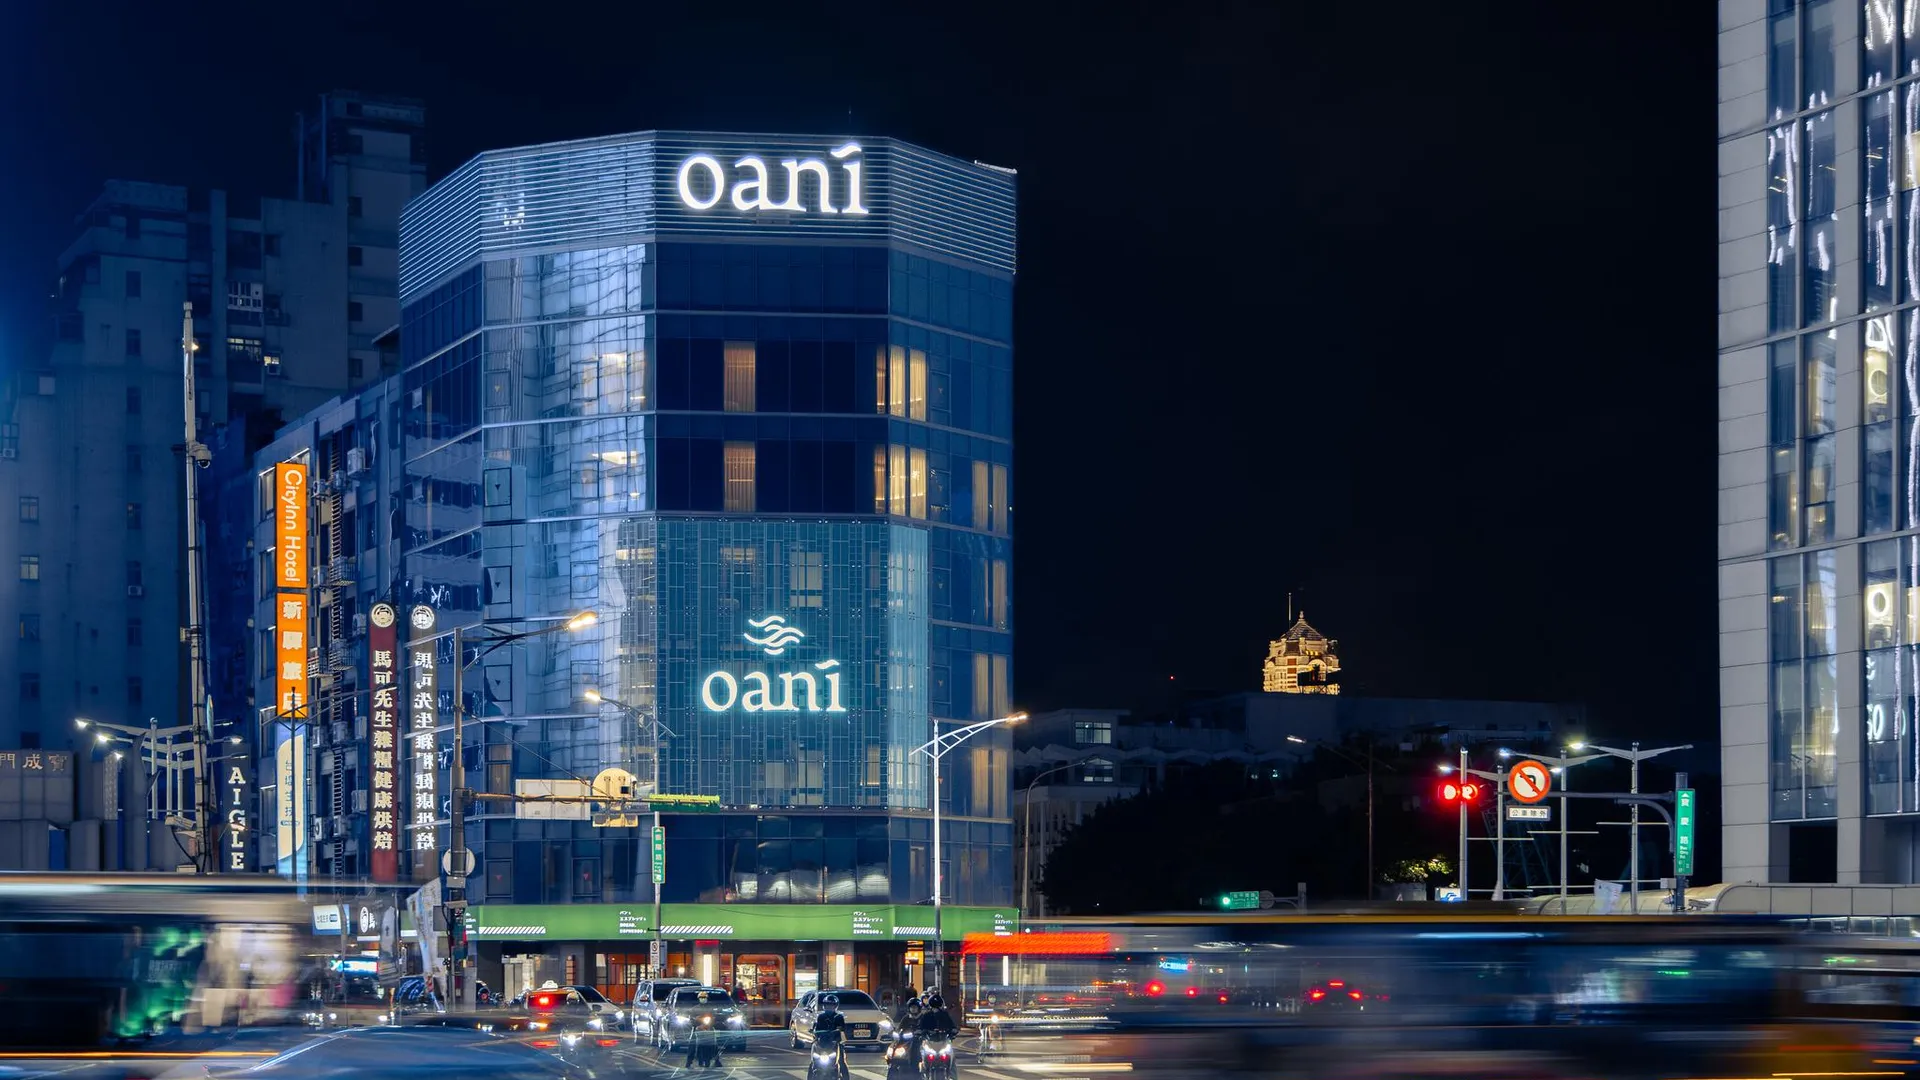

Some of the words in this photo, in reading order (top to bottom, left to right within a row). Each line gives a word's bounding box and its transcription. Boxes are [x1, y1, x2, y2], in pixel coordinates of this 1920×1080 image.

[284, 469, 303, 530] CityInn
[285, 535, 301, 583] Hotel
[228, 766, 247, 870] AIGLE
